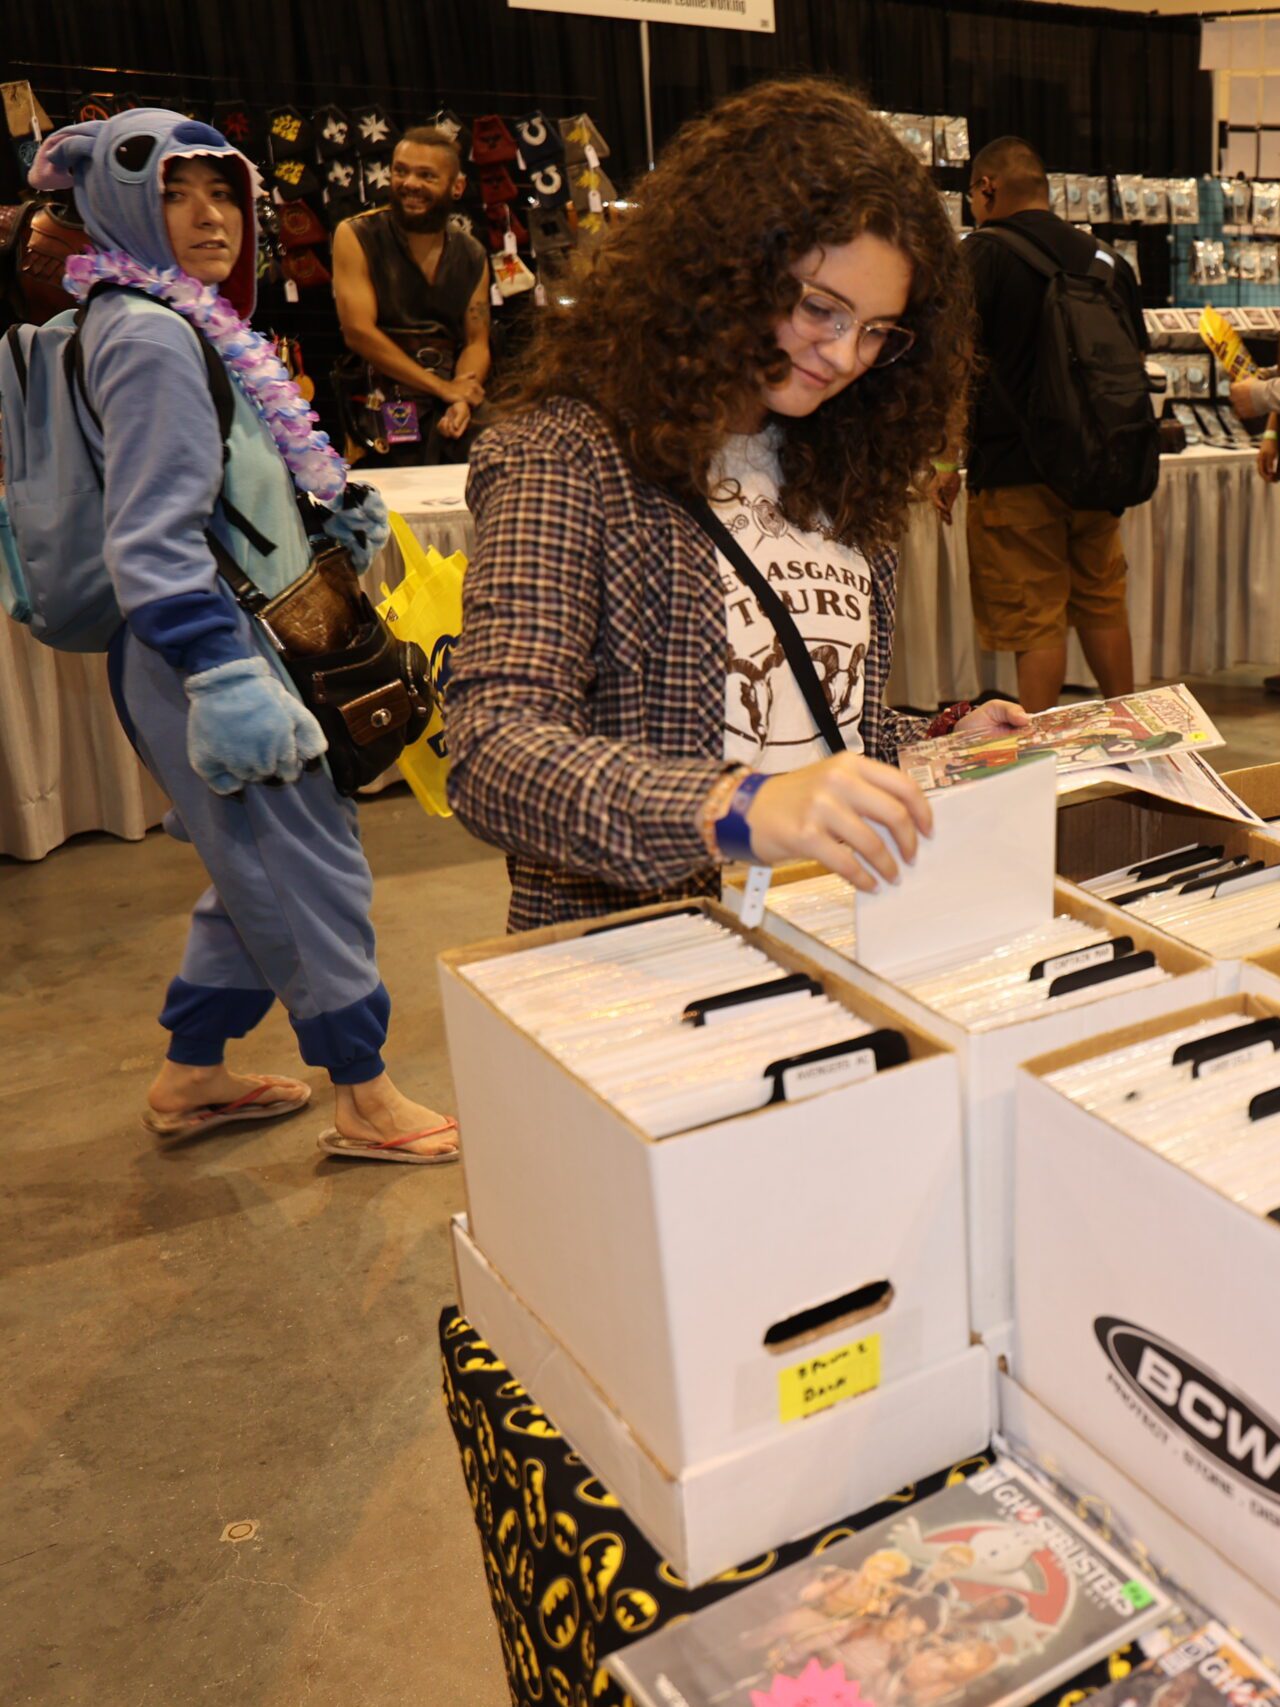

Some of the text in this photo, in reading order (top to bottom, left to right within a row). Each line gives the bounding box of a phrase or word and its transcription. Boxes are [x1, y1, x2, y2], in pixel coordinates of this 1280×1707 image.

[767, 561, 871, 597] ASGARD
[729, 588, 862, 627] TURS
[1106, 1372, 1169, 1444] PROTECT
[1183, 1451, 1235, 1498] STORE
